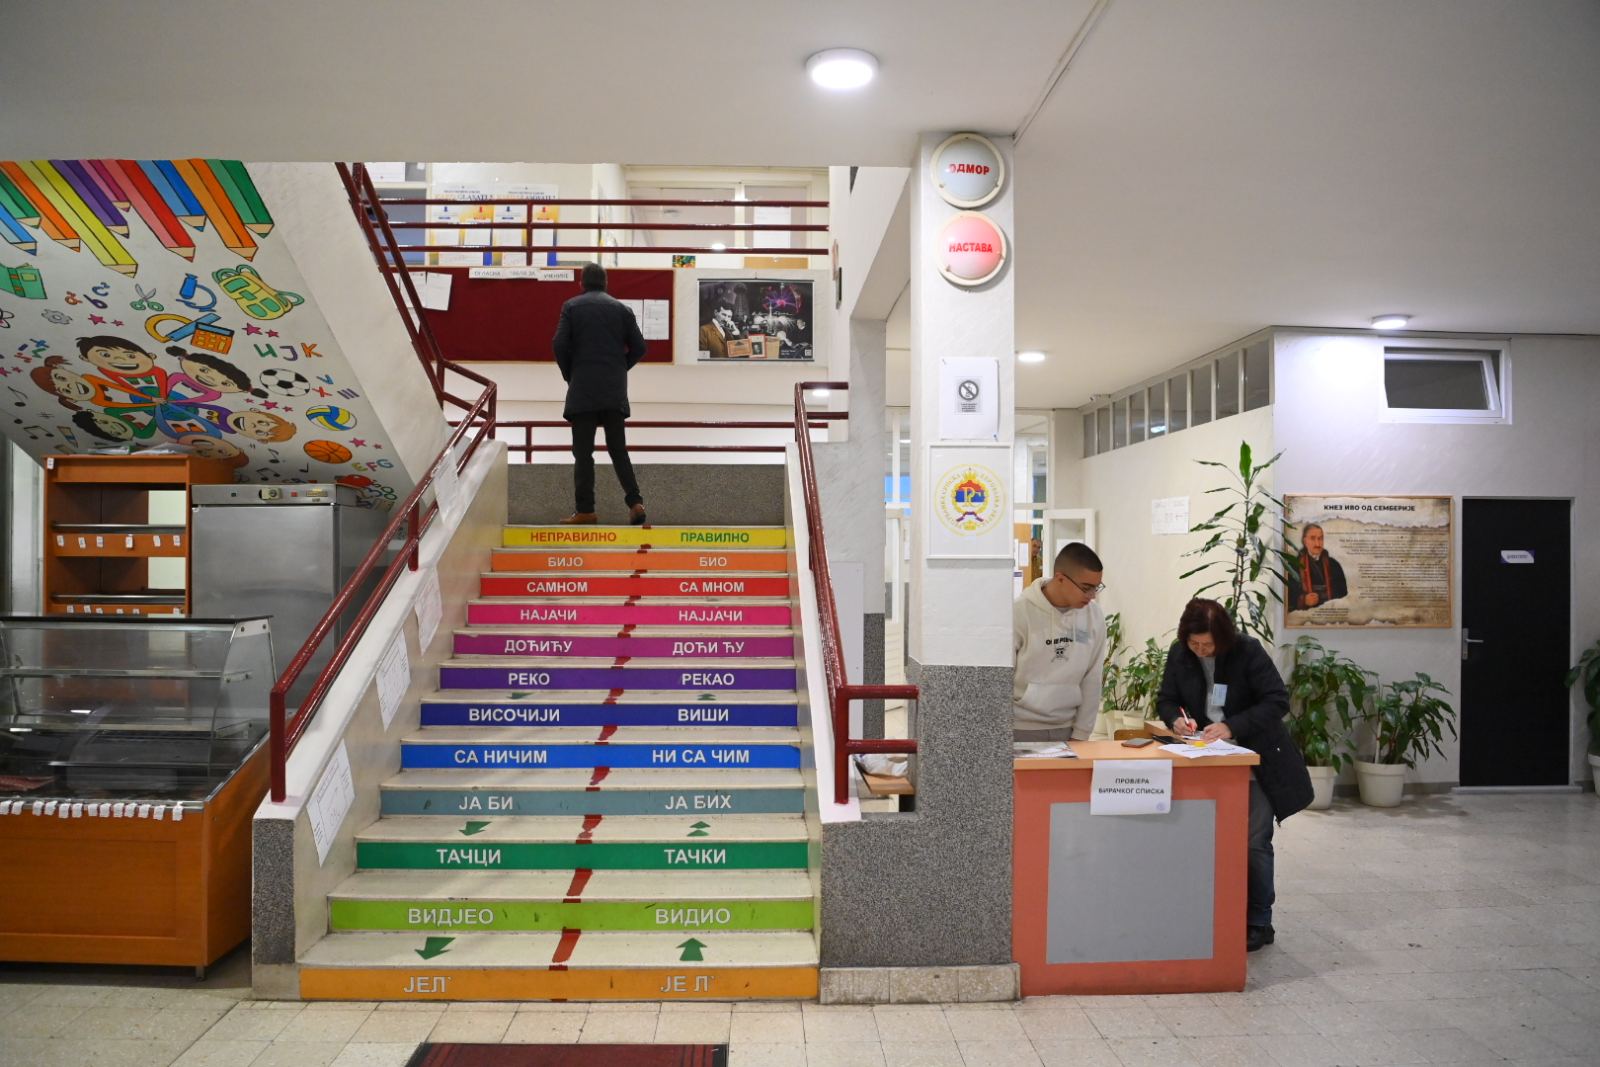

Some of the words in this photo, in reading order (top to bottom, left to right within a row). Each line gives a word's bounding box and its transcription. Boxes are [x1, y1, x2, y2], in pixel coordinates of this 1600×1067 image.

[948, 163, 991, 175] ОДМОР
[948, 242, 993, 253] НАСТАВА
[1361, 504, 1372, 512] ОД
[1373, 504, 1416, 512] СЕМБЕРИЈЕ
[530, 531, 617, 542] НЕПРАВИЛНО
[680, 532, 750, 543] ПРАВИЛНО
[548, 556, 584, 567] БИЈО
[699, 556, 728, 567] БИО
[526, 581, 588, 593] САМНОМ
[679, 581, 699, 593] СА
[702, 581, 745, 593] МНОМ
[520, 609, 577, 621] НАЈАЧИ
[678, 610, 743, 622] НАЈЈАЧИ
[504, 639, 573, 654] ДОЋИЋУ
[672, 641, 718, 655] ДОЋИ
[722, 641, 745, 653] ЋУ
[508, 672, 551, 686] РЕКО
[681, 672, 735, 686] РЕКАО
[468, 708, 561, 723] ВИСОЧИЈИ
[677, 708, 729, 722] ВИШИ
[454, 749, 480, 764] СА
[485, 749, 548, 764] НИЧИМ
[652, 749, 677, 763] НИ
[681, 749, 707, 764] СА
[711, 748, 750, 763] ЧИМ
[1114, 777, 1150, 785] ПРОВЈЕРА
[1098, 787, 1134, 795] БИРАЧКОГ
[458, 796, 482, 810] ЈА
[488, 796, 513, 810] БИ
[664, 795, 690, 810] ЈА
[694, 795, 732, 810] БИХ
[436, 849, 502, 868] ТАЧЦИ
[664, 849, 727, 865] ТАЧКИ
[408, 908, 494, 928] ВИДЈЕО
[655, 908, 731, 927] ВИДИО
[660, 975, 687, 993] ЈЕ
